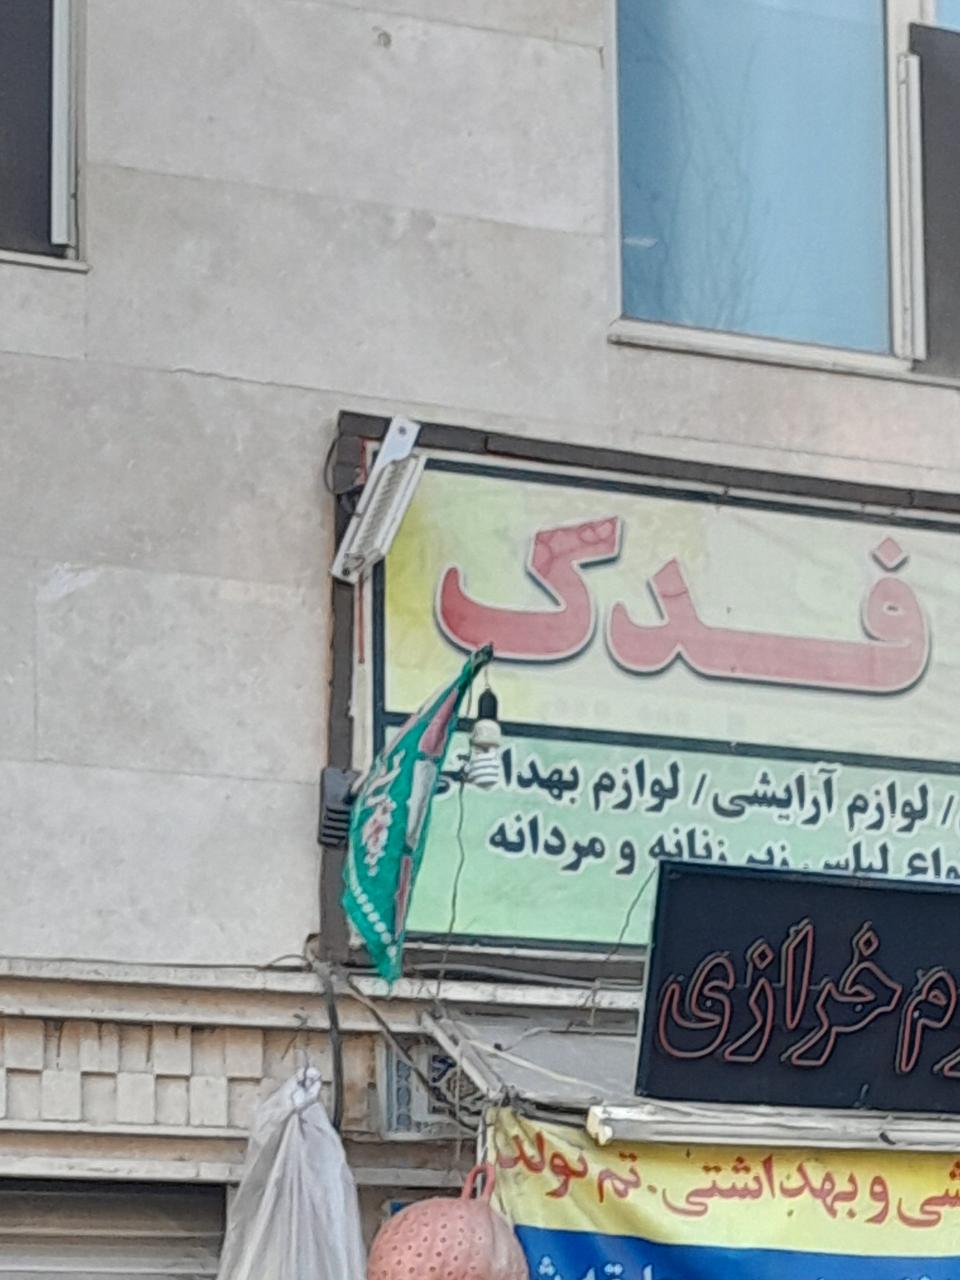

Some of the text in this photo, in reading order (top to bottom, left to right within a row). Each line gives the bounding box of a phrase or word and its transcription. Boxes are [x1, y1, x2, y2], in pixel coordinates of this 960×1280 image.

[434, 514, 930, 693] فدک
[593, 760, 681, 813] لوازم
[712, 767, 838, 826] آرایشی
[847, 781, 929, 832] لوازم
[488, 812, 606, 873] مردانه
[658, 916, 903, 1067] خرازی
[597, 1151, 642, 1204] تم
